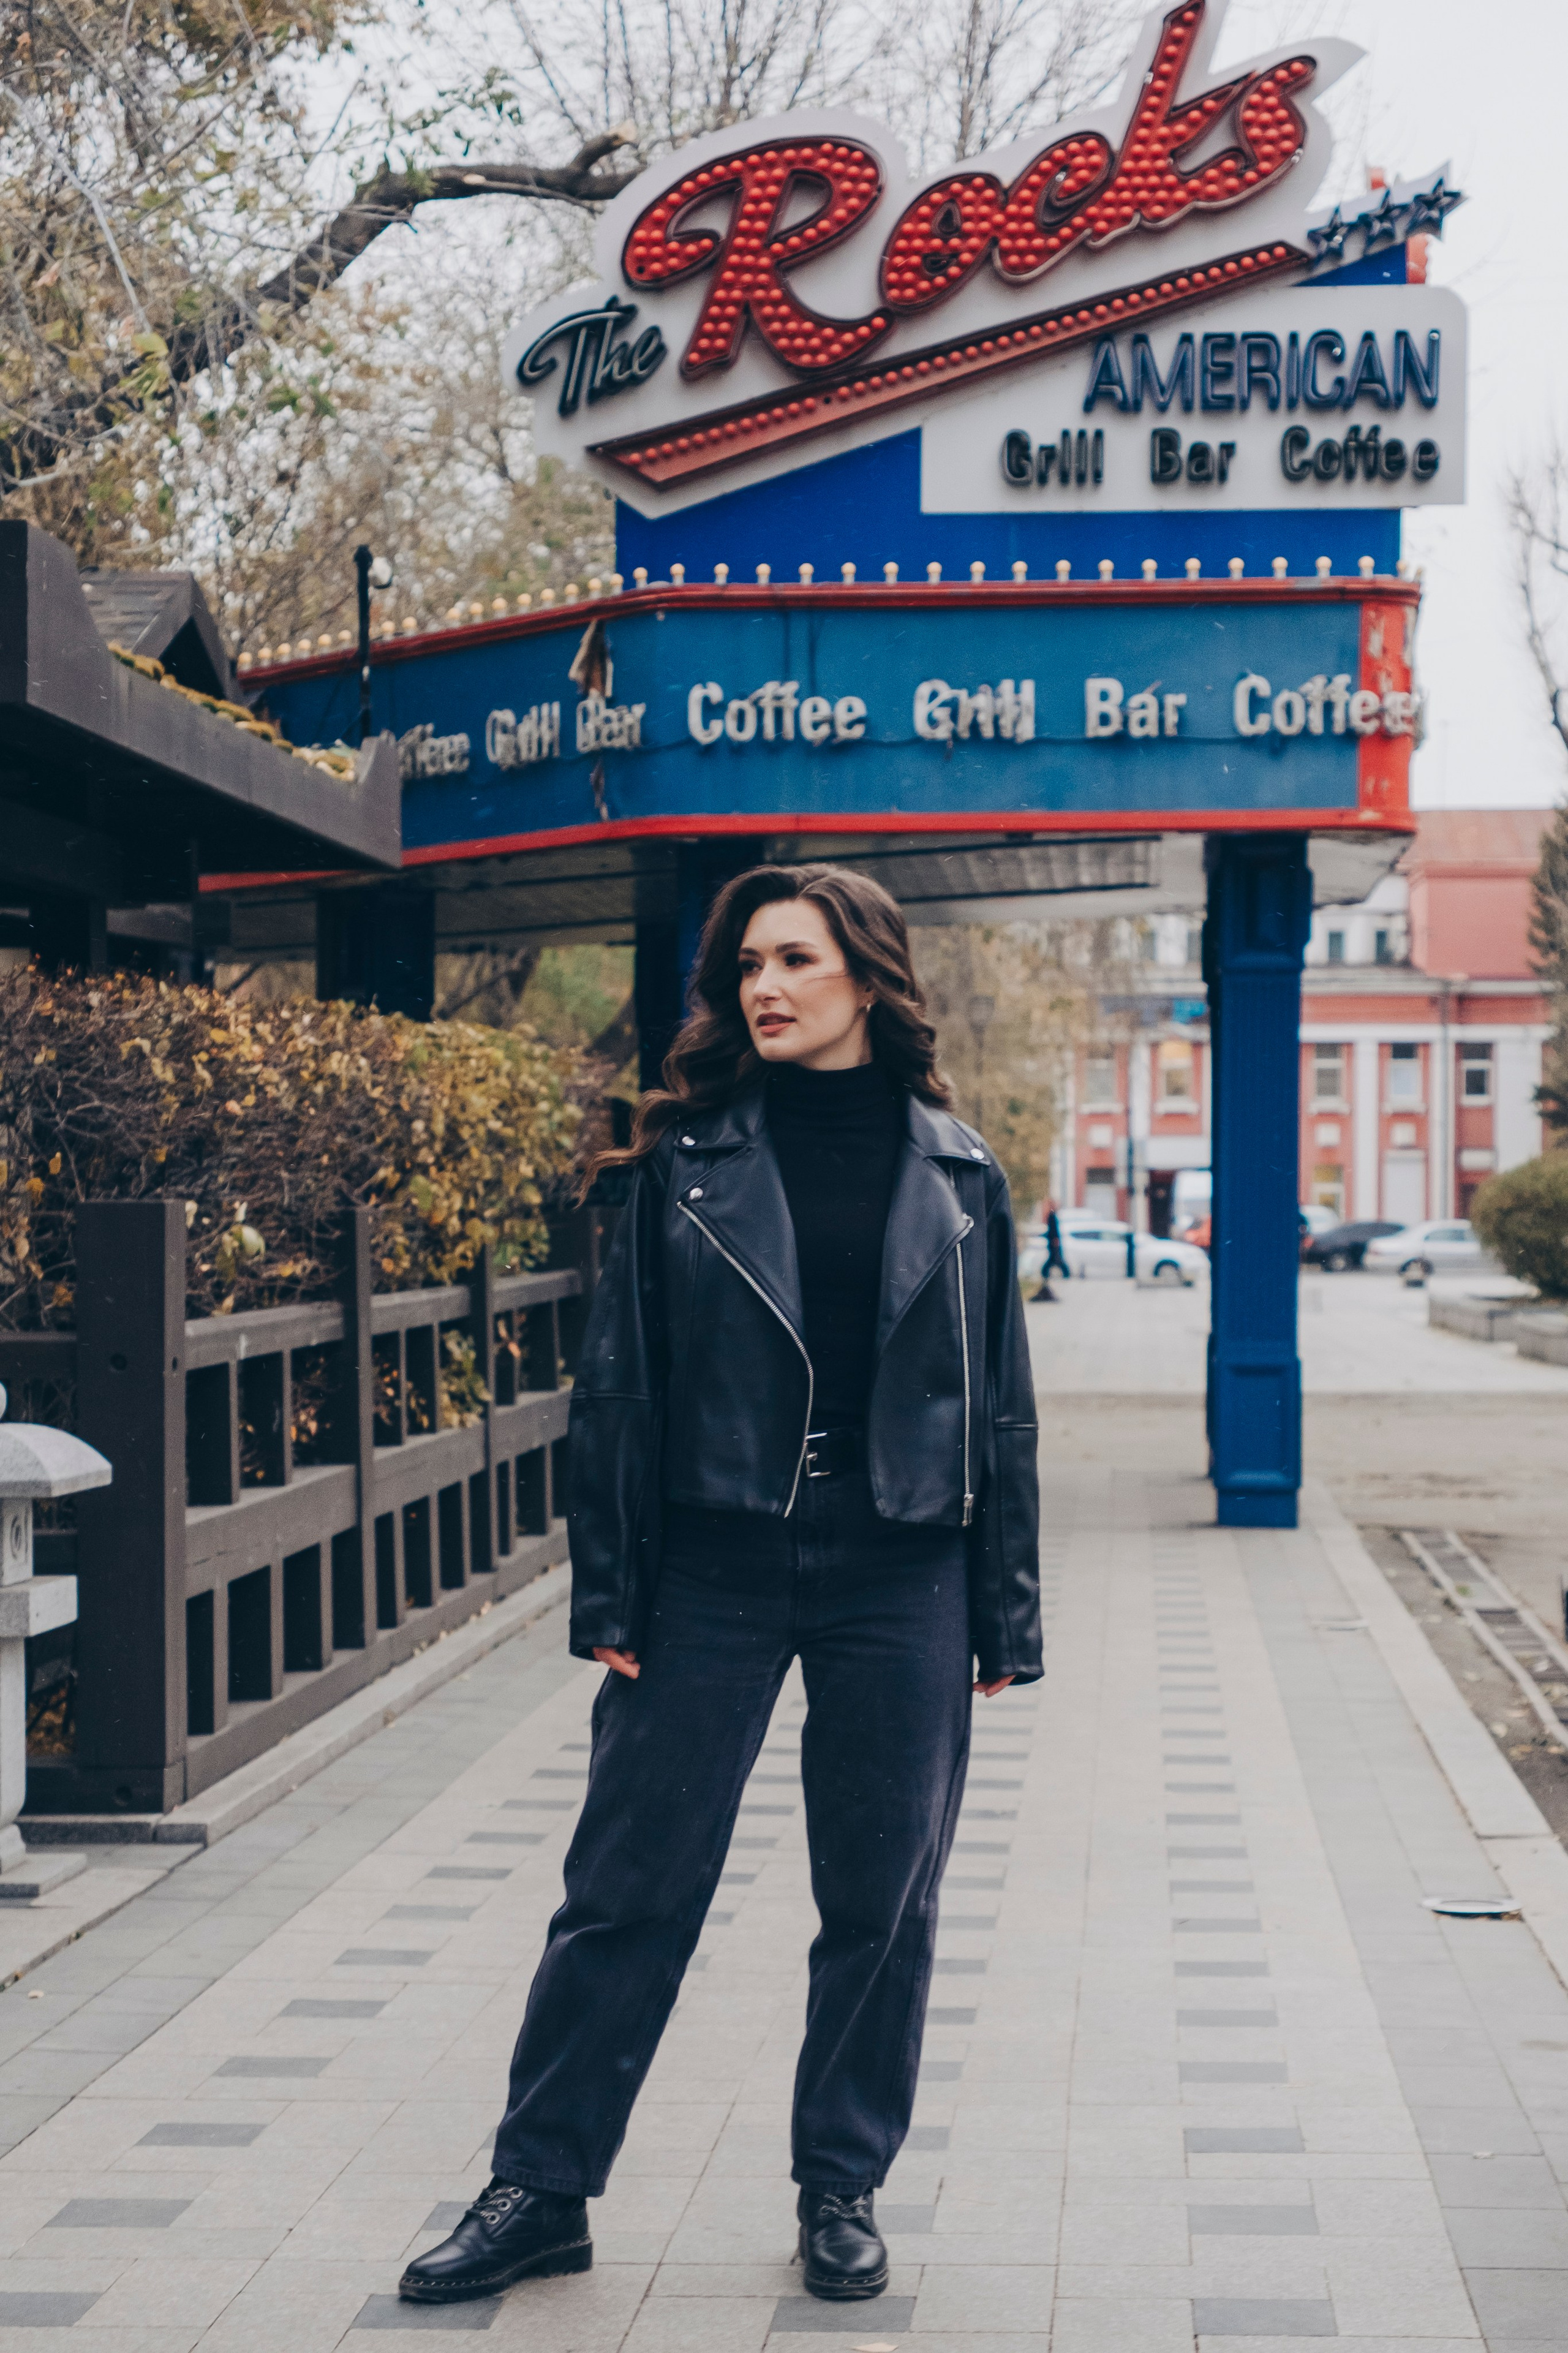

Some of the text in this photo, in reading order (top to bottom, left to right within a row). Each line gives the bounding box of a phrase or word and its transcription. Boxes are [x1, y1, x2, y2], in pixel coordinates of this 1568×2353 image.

[515, 0, 1317, 418] The Rocks
[1082, 329, 1441, 414] AMERICAN
[1001, 425, 1441, 487] Grill Bar Coffee
[397, 673, 1420, 779] ffee Grill Bar Coffee Grill Bar Coffee
